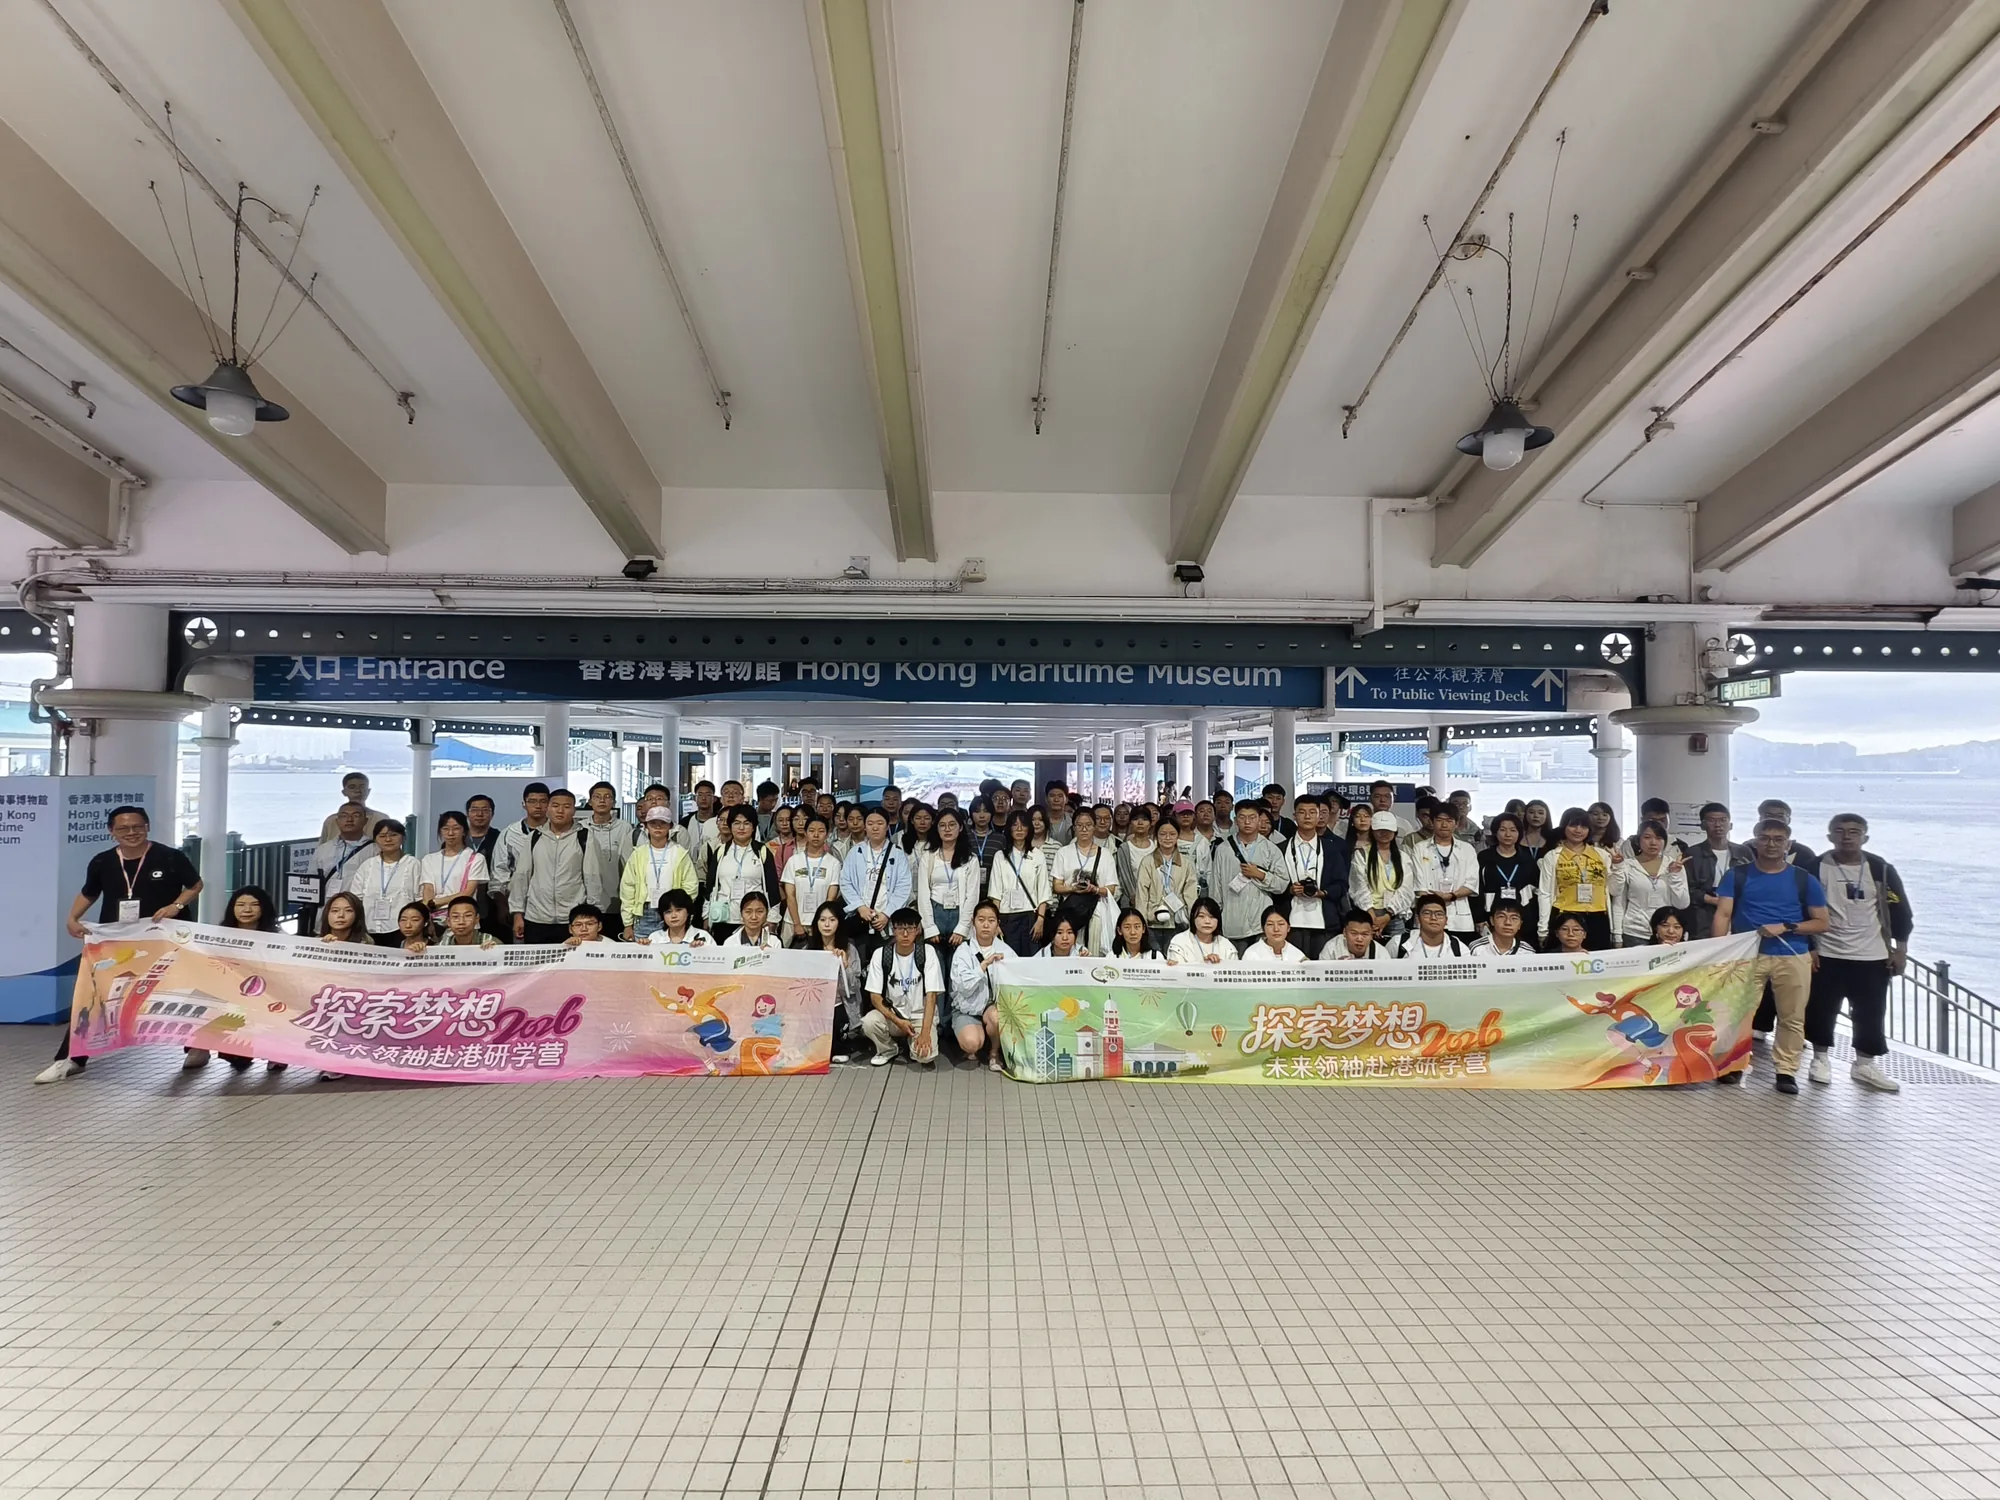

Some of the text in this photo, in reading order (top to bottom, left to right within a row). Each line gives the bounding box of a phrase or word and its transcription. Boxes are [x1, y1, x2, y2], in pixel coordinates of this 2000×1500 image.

[285, 656, 341, 681] 入口
[357, 656, 505, 680] Entrance
[578, 660, 781, 681] 香港海事博物館
[797, 661, 1282, 688] Hong Kong Maritime Museum
[1370, 688, 1529, 704] To Public Viewing Deck
[1721, 679, 1769, 700] EXIT 出口
[7, 810, 36, 822] Kong
[68, 810, 100, 820] Hong
[294, 987, 587, 1044] 探索梦想 2026
[1241, 1003, 1503, 1057] 探索梦想 2026
[1266, 1052, 1488, 1079] 未来领袖赴港研学营
